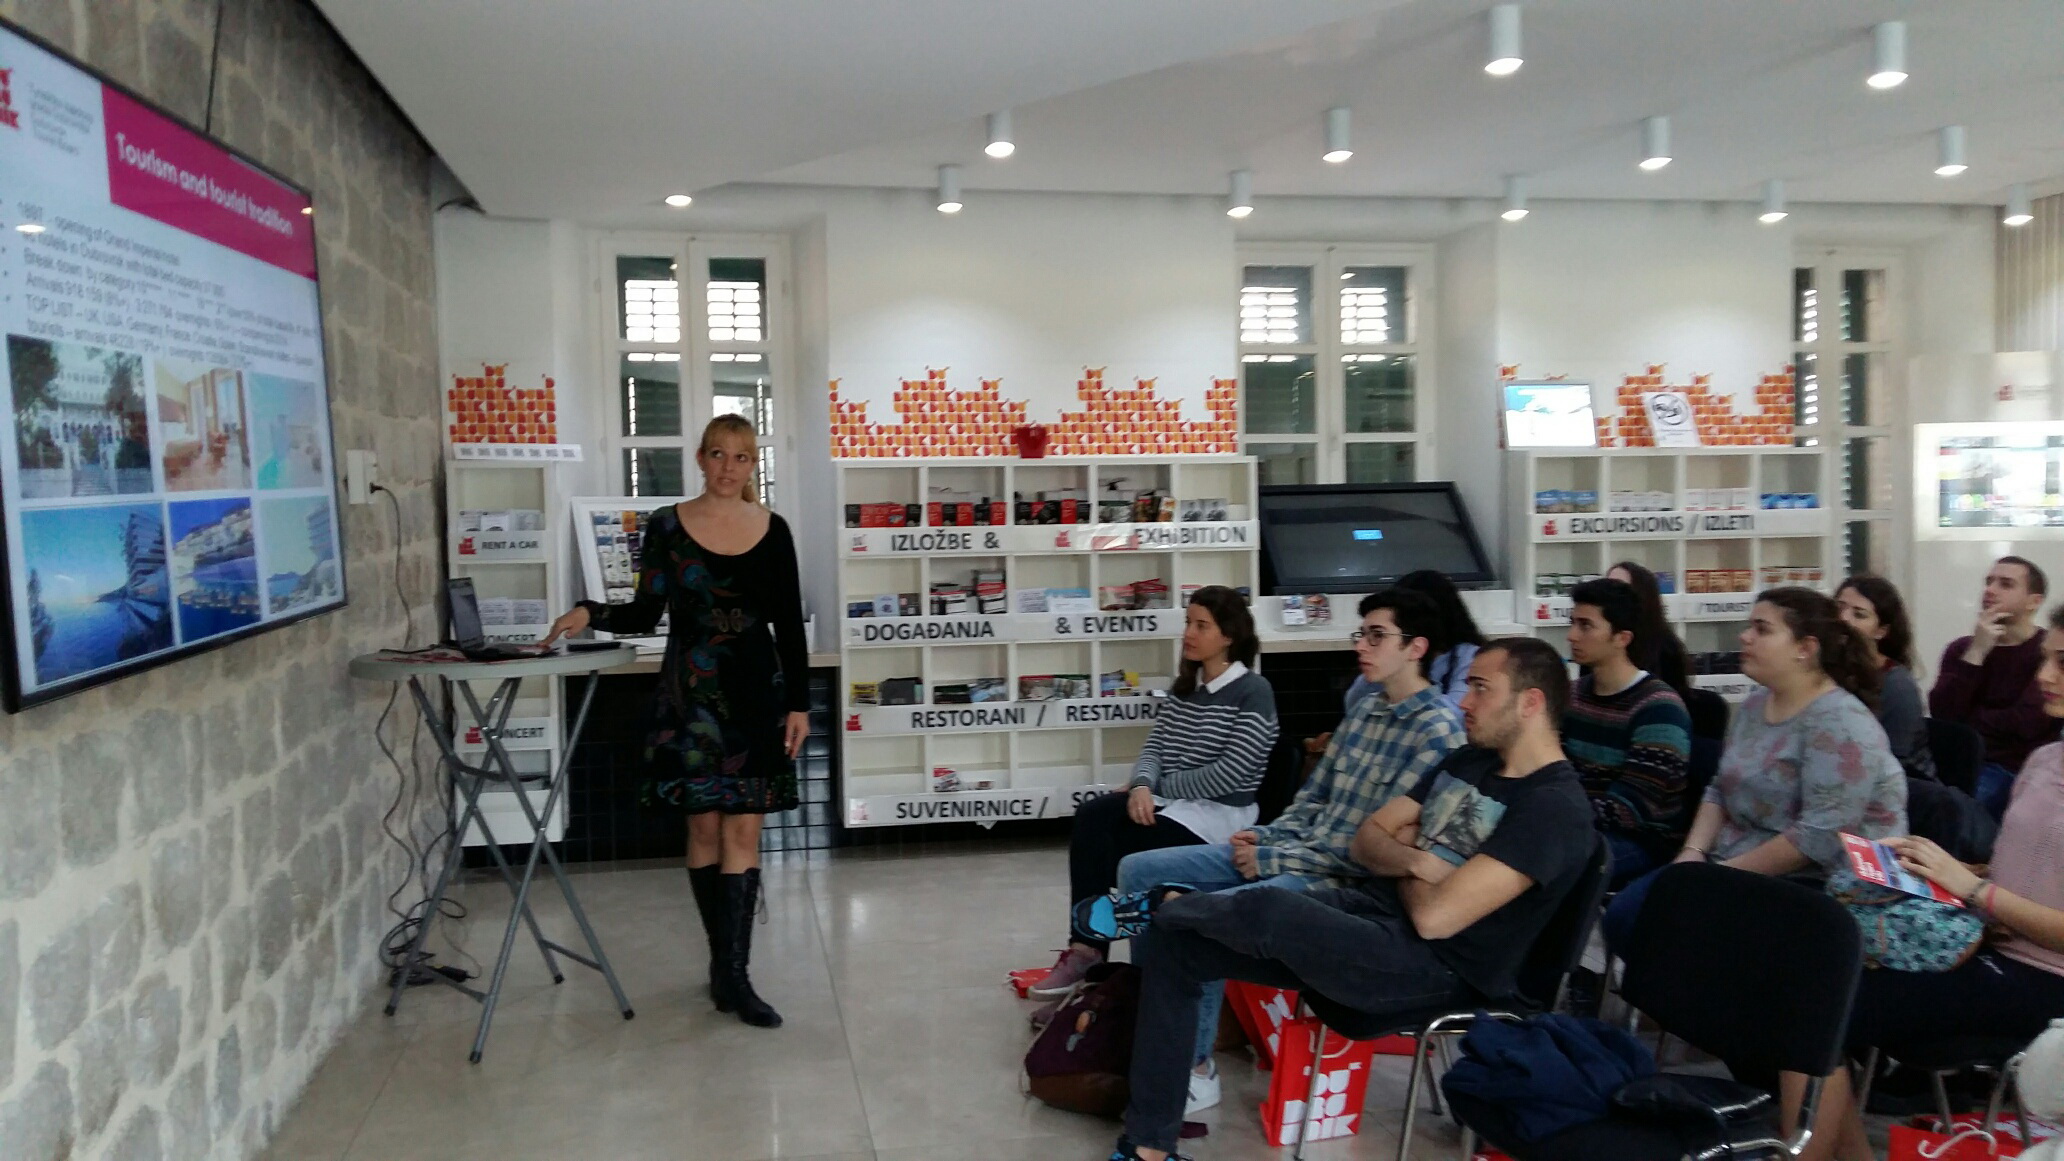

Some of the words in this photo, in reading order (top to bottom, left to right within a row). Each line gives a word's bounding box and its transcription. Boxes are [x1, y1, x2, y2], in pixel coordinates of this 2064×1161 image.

[115, 131, 178, 185] Tourism
[179, 169, 208, 199] and
[209, 177, 247, 216] tourist
[247, 196, 294, 238] tradition
[1571, 515, 1684, 534] EXCURSIONS
[1688, 514, 1699, 534] /
[1705, 514, 1754, 531] IZLETI
[481, 541, 507, 550] RENT
[509, 541, 516, 549] A
[518, 541, 539, 549] CAR
[891, 529, 972, 551] IZLOŽBE
[984, 531, 1000, 549] &
[1134, 526, 1247, 545] EXHIBITION
[864, 620, 995, 642] DOGAĐANJA
[1055, 617, 1072, 634] &
[1083, 615, 1158, 634] EVENTS
[911, 707, 1026, 728] RESTORANI
[1036, 704, 1047, 727] /
[896, 799, 1032, 819] SUVENIRNICE
[1037, 796, 1049, 818] /
